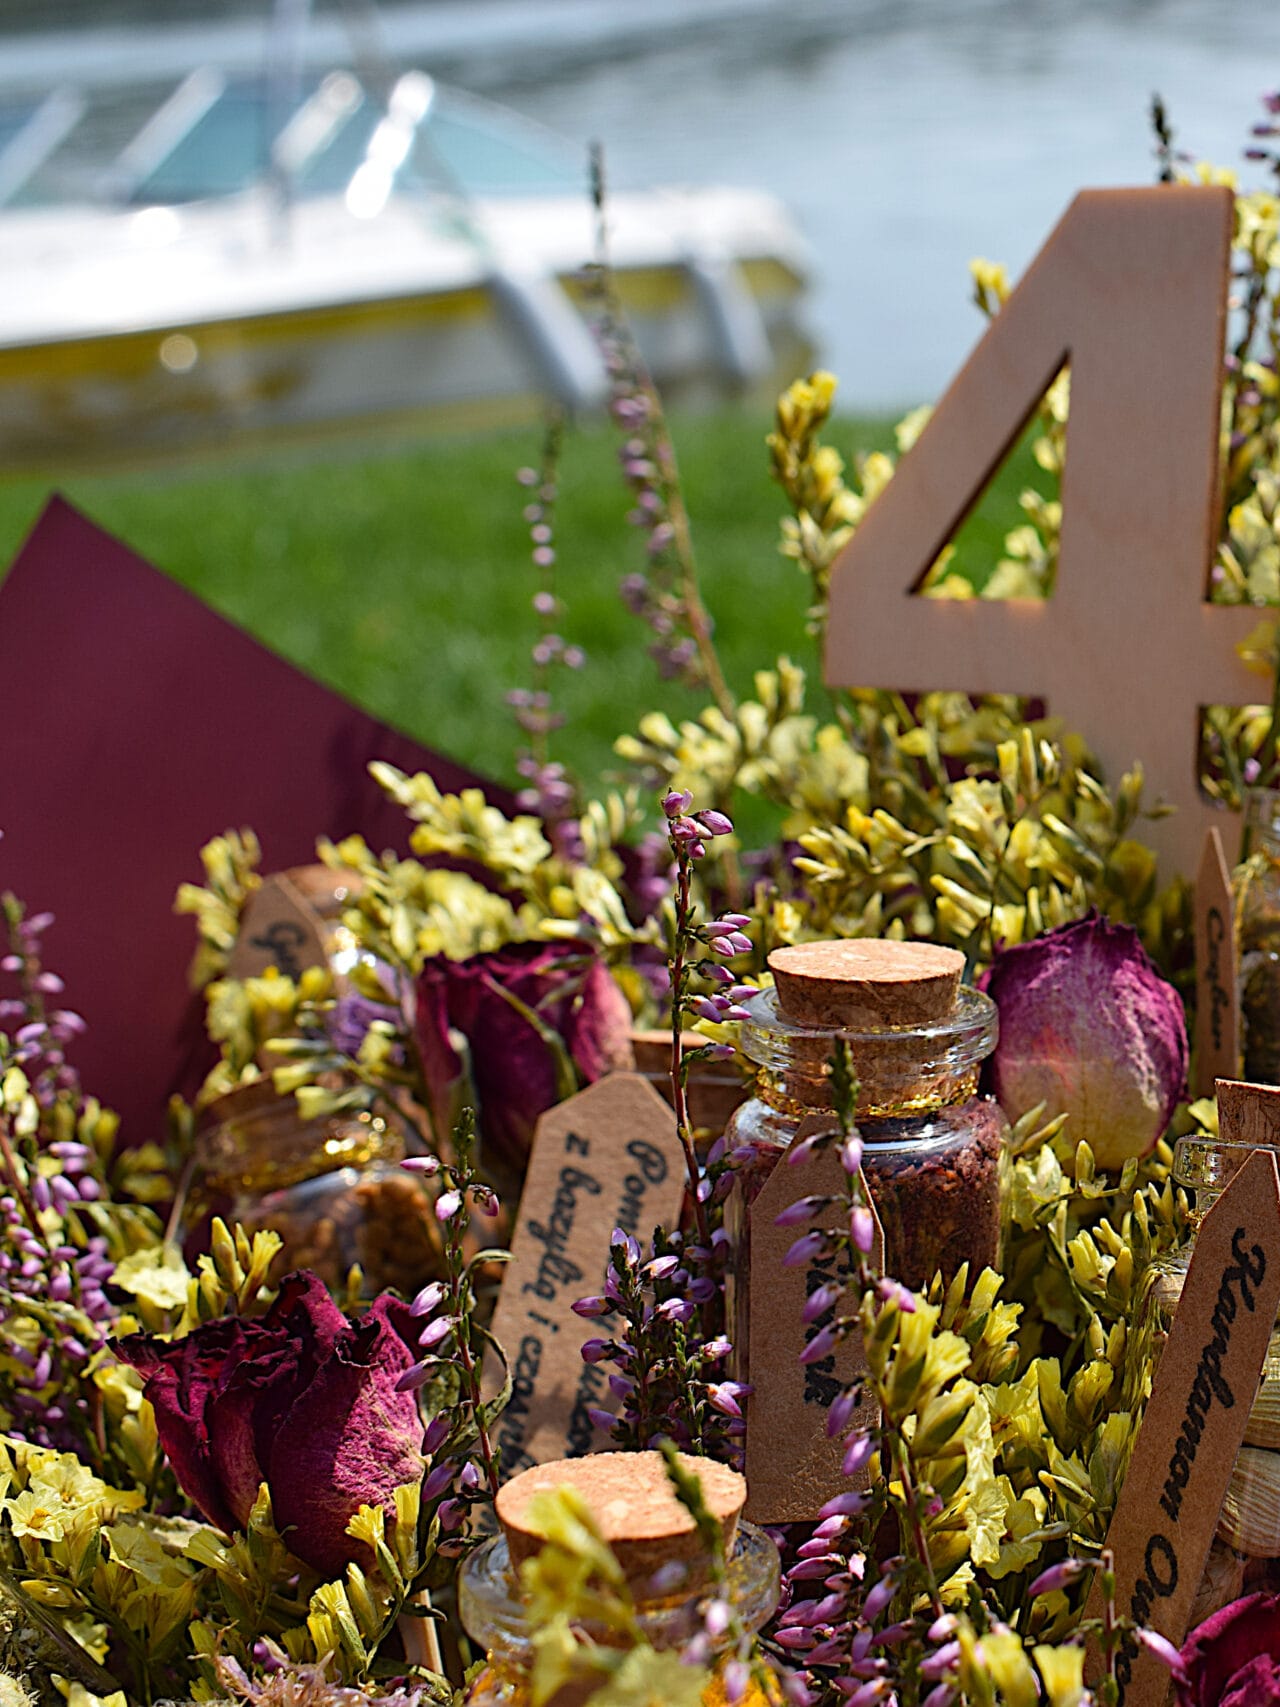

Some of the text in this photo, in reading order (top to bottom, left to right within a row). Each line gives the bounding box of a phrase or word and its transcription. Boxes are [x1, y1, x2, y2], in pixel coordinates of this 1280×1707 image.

[566, 1132, 590, 1157] z
[528, 1311, 559, 1333] i
[1159, 1226, 1266, 1523] Kardamon
